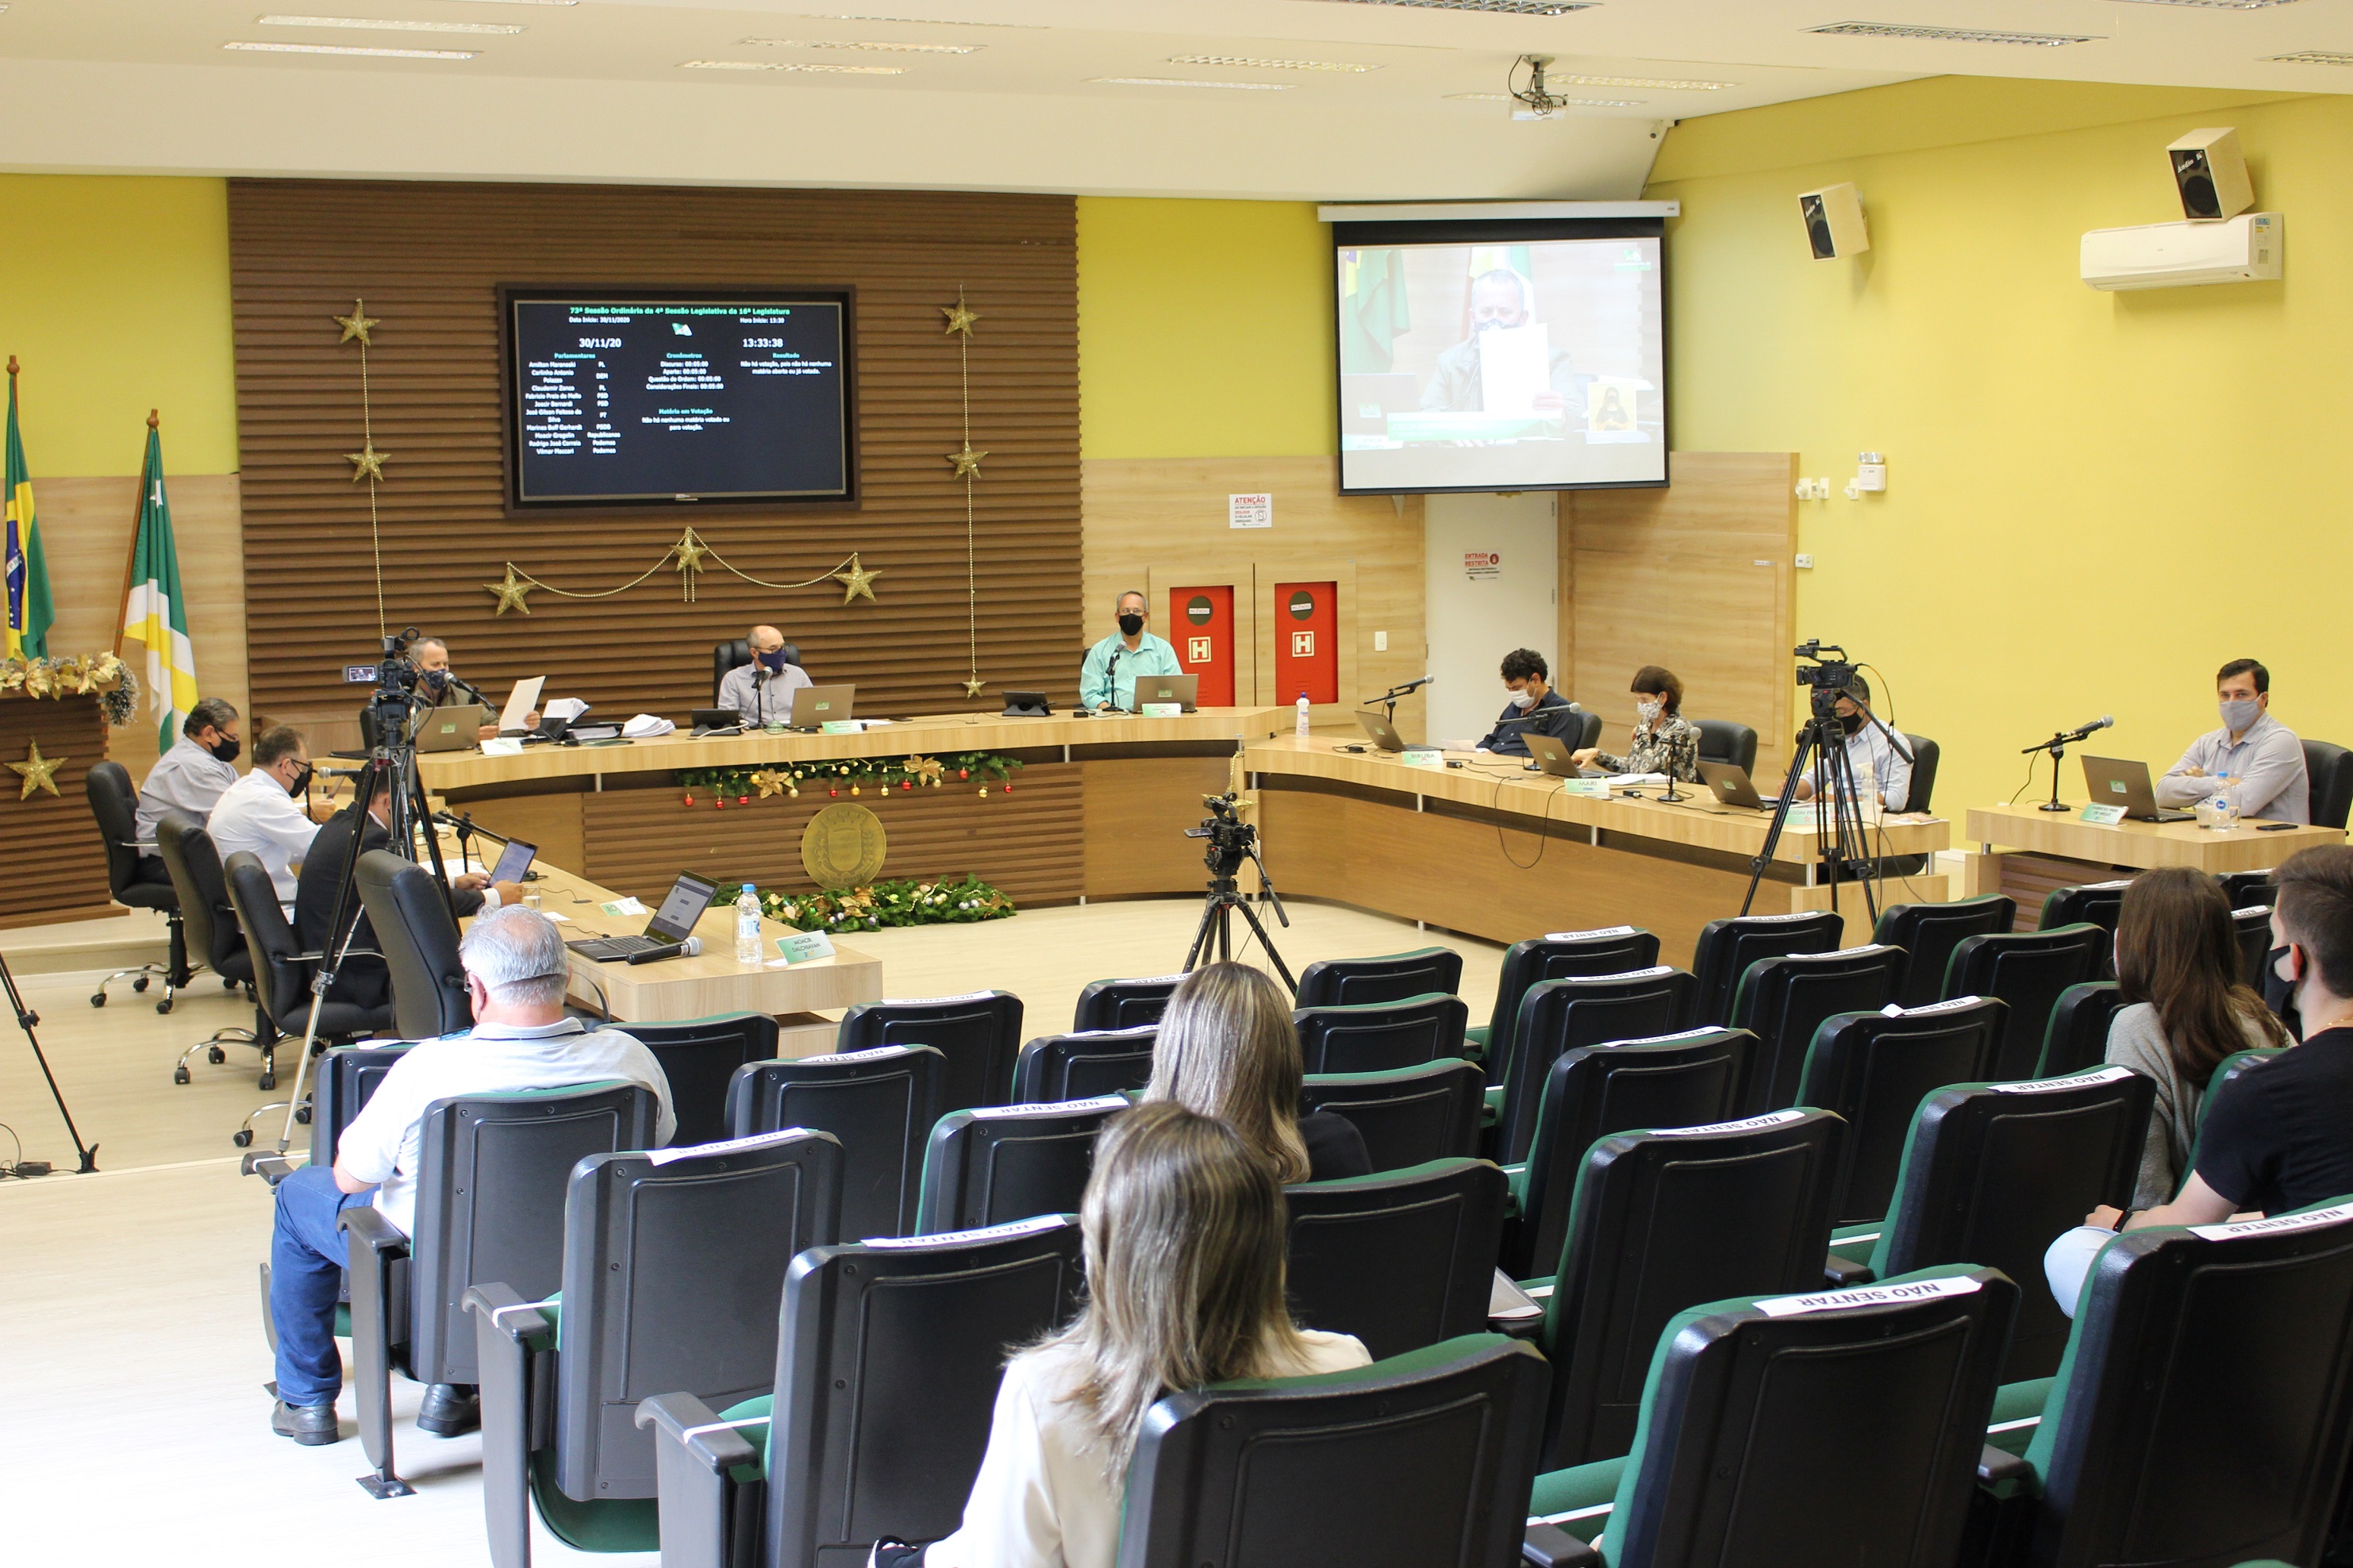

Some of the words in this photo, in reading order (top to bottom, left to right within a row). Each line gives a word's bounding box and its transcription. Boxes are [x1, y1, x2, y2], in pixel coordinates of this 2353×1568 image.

[610, 306, 644, 315] Ordinária
[579, 338, 622, 348] 30/11/20
[743, 338, 783, 348] 13:33:38
[1235, 495, 1266, 505] ATENÇÃO
[1192, 640, 1208, 659] H
[1295, 635, 1310, 653] H
[2014, 1080, 2073, 1090] SENTAR
[1746, 1116, 1782, 1126] NÃO
[1680, 1123, 1744, 1133] SENTAR
[2300, 1209, 2345, 1222] NÃO
[2224, 1216, 2301, 1233] SENTAR
[900, 1232, 982, 1244] SENTAR
[1891, 1282, 1942, 1297] NÃO
[1797, 1290, 1888, 1306] SENTAR
